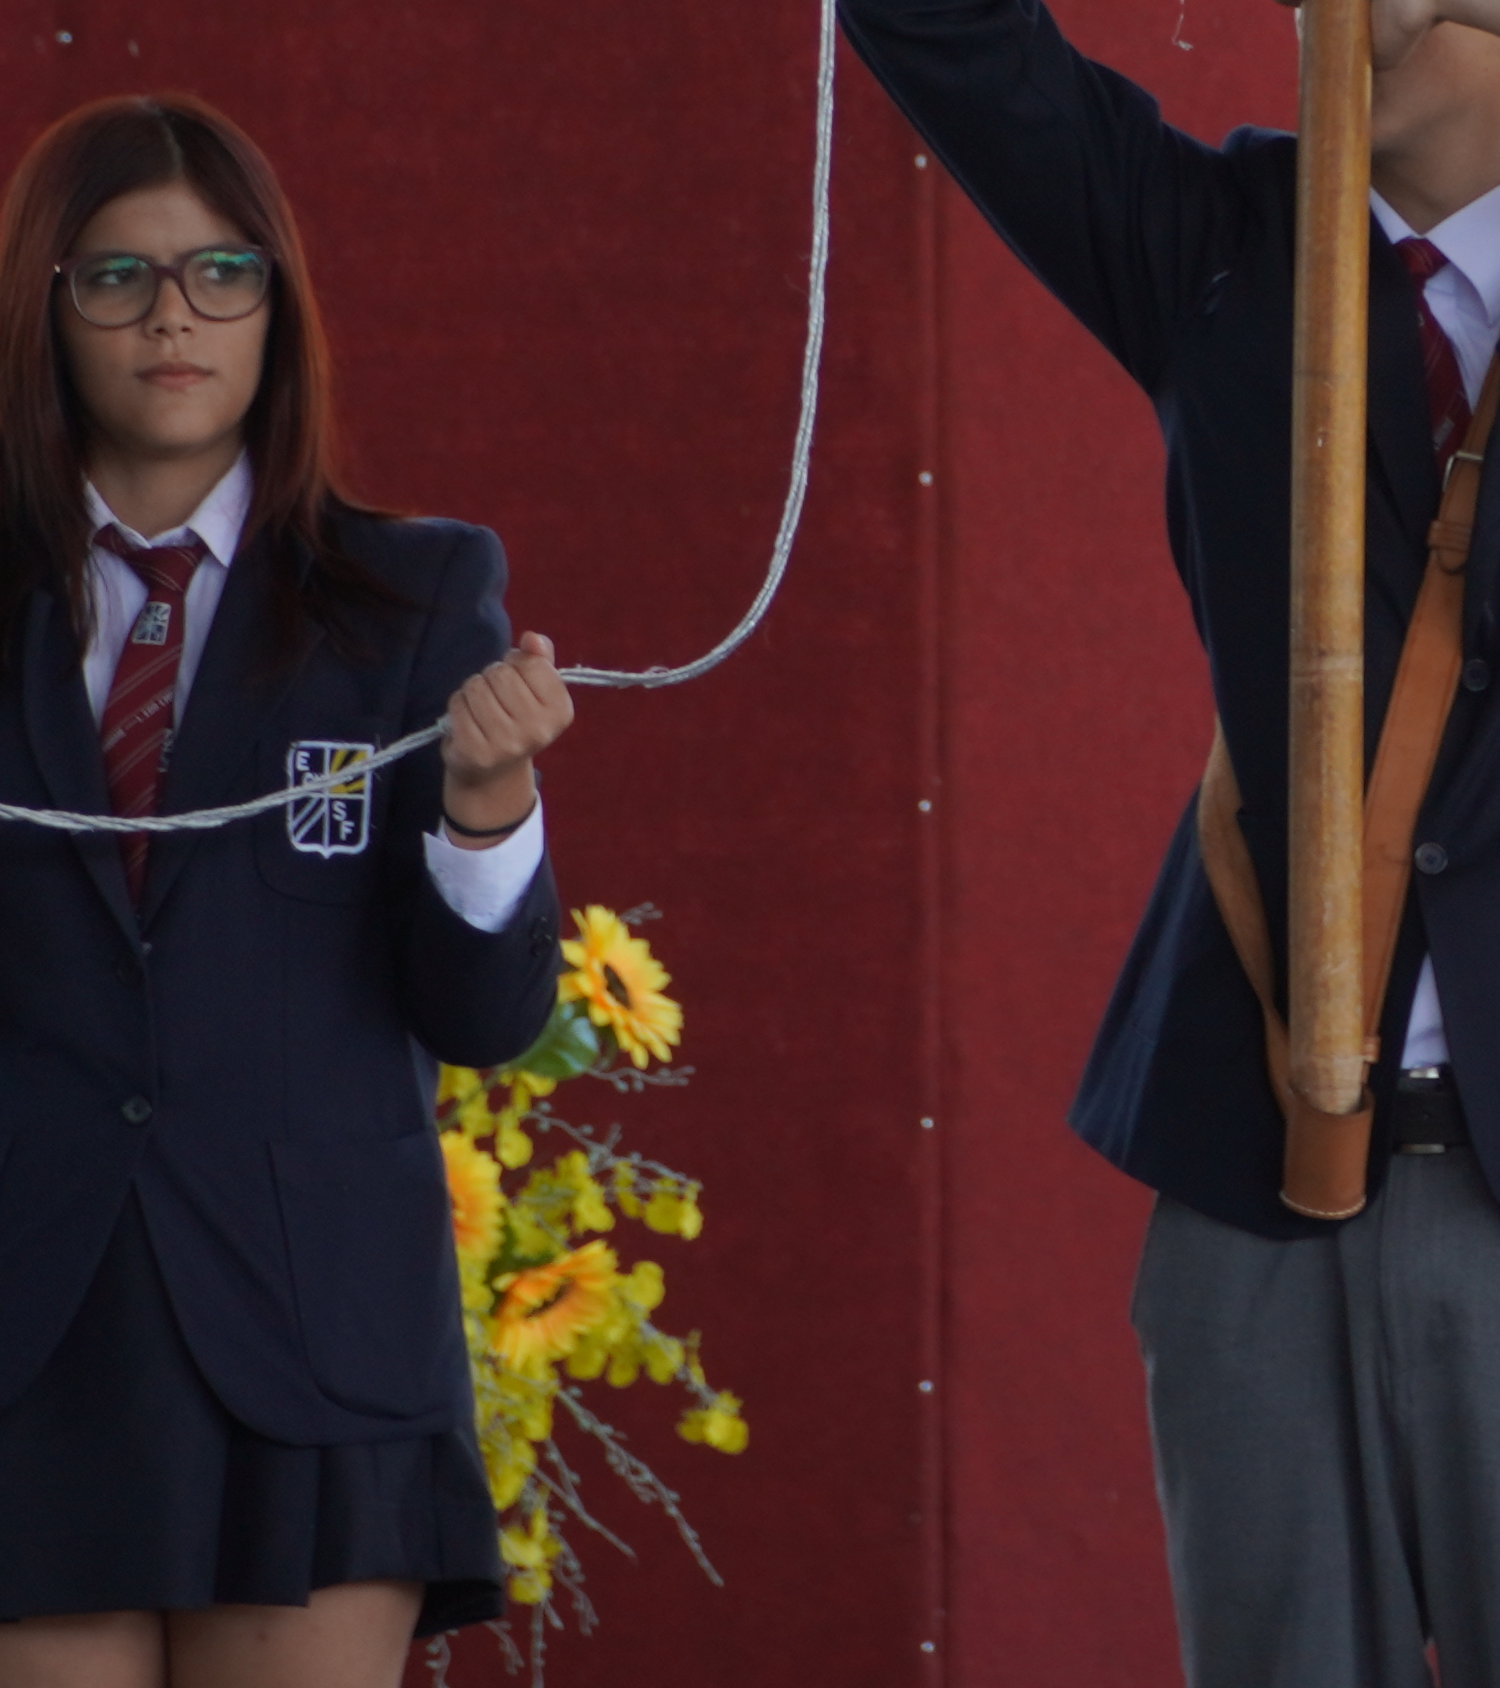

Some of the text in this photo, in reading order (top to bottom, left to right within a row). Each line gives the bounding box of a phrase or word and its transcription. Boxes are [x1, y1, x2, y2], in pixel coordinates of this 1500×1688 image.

[296, 750, 310, 771] E
[332, 801, 347, 821] S
[340, 820, 355, 841] F
